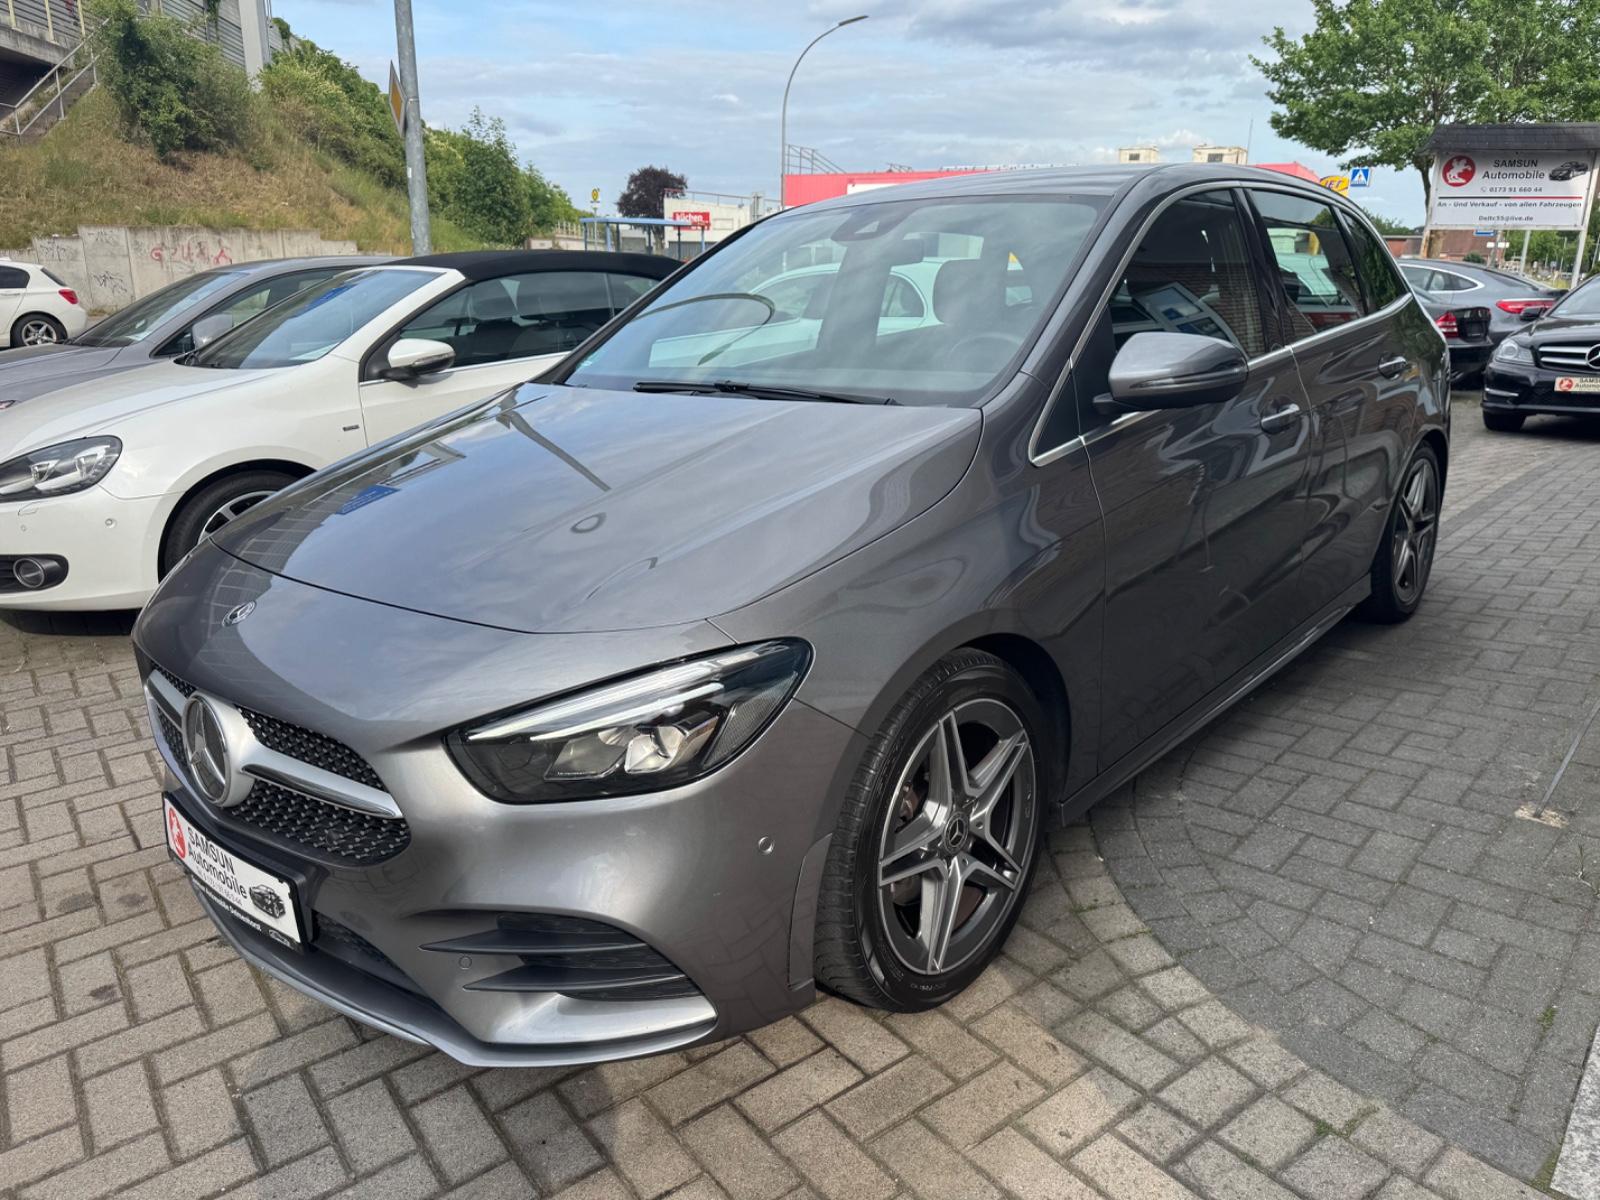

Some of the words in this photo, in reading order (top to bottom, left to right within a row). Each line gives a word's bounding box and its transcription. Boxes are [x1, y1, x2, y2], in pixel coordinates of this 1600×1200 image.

[1482, 170, 1545, 180] Automobile
[1493, 159, 1539, 168] SAMSUN
[188, 827, 235, 874] SAMSUN
[188, 842, 247, 899] Automobile
